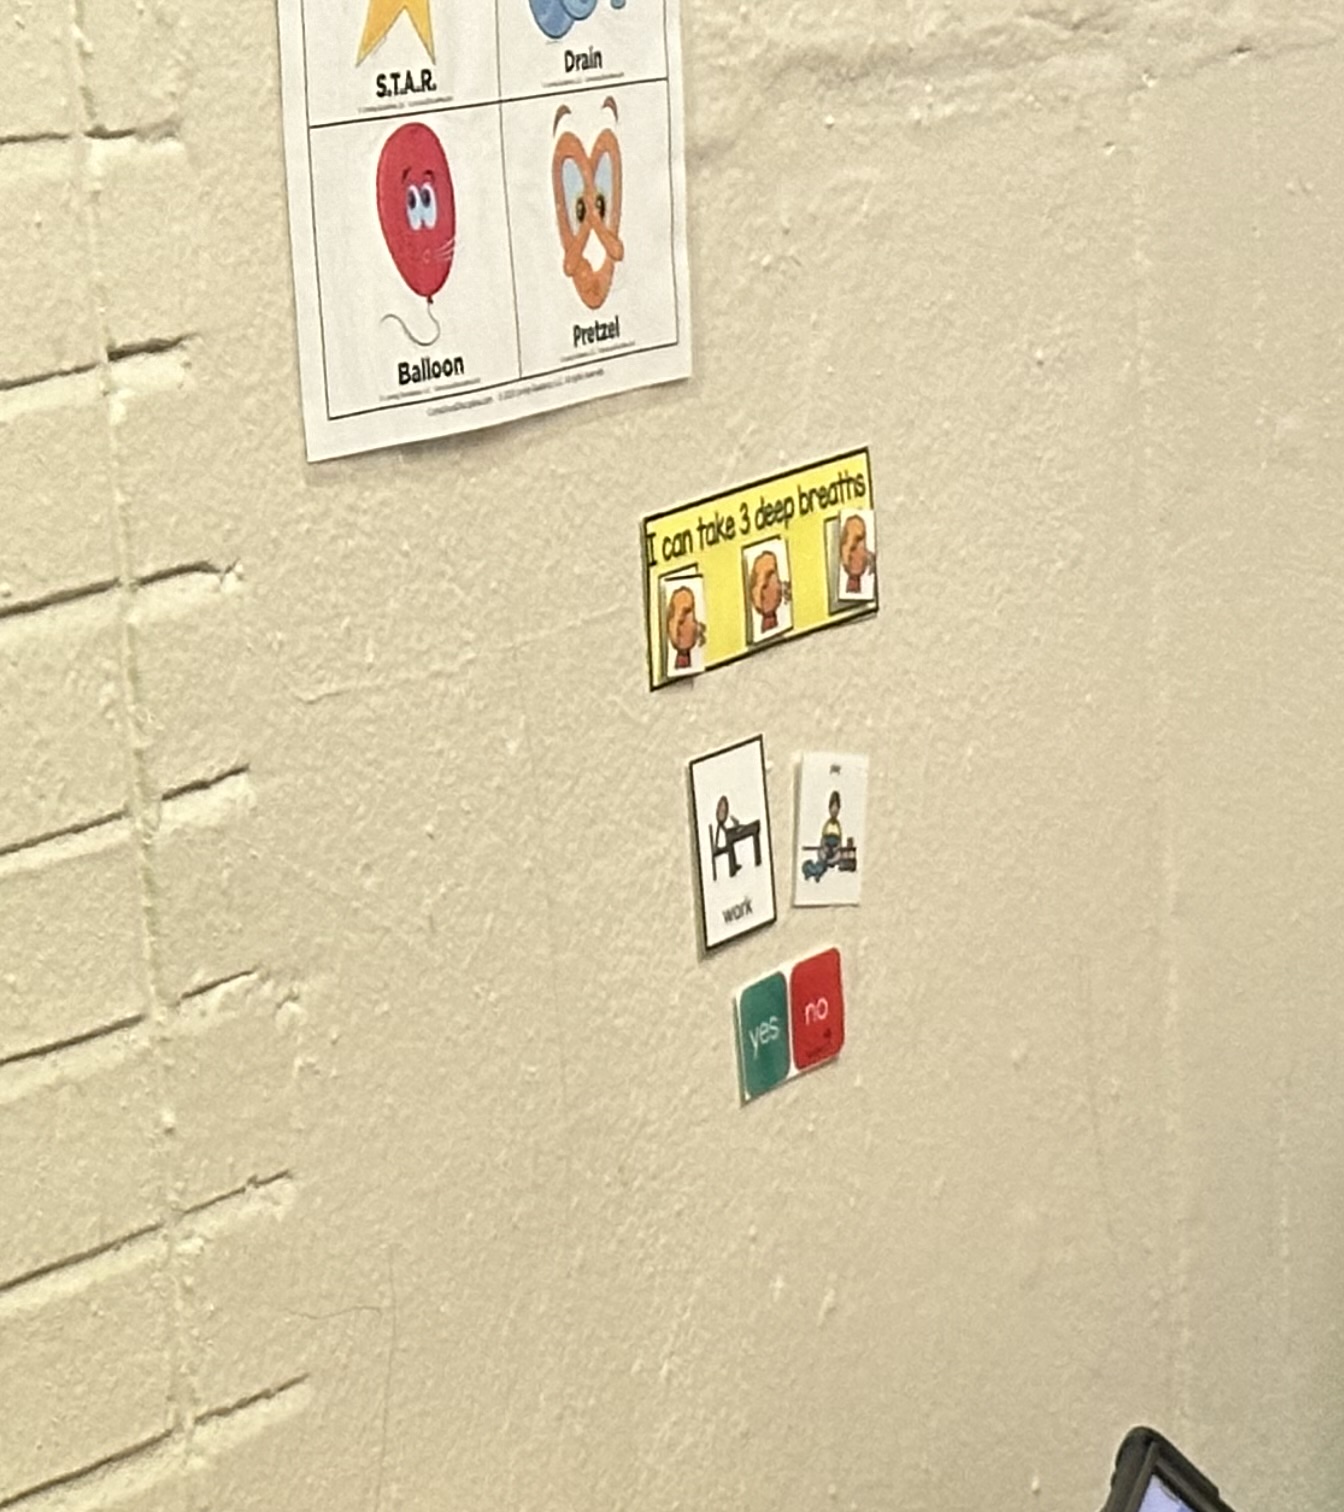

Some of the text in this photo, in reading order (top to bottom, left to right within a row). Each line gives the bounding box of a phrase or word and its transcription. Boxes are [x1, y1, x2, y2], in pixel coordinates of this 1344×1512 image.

[564, 46, 603, 73] Drain
[376, 69, 437, 98] S.T.A.R.
[572, 315, 620, 348] Pretzel
[397, 356, 465, 386] Balloon
[645, 470, 866, 566] I can take 3 deep breaths
[722, 896, 754, 925] work
[804, 996, 829, 1027] no
[749, 1014, 780, 1061] yes
